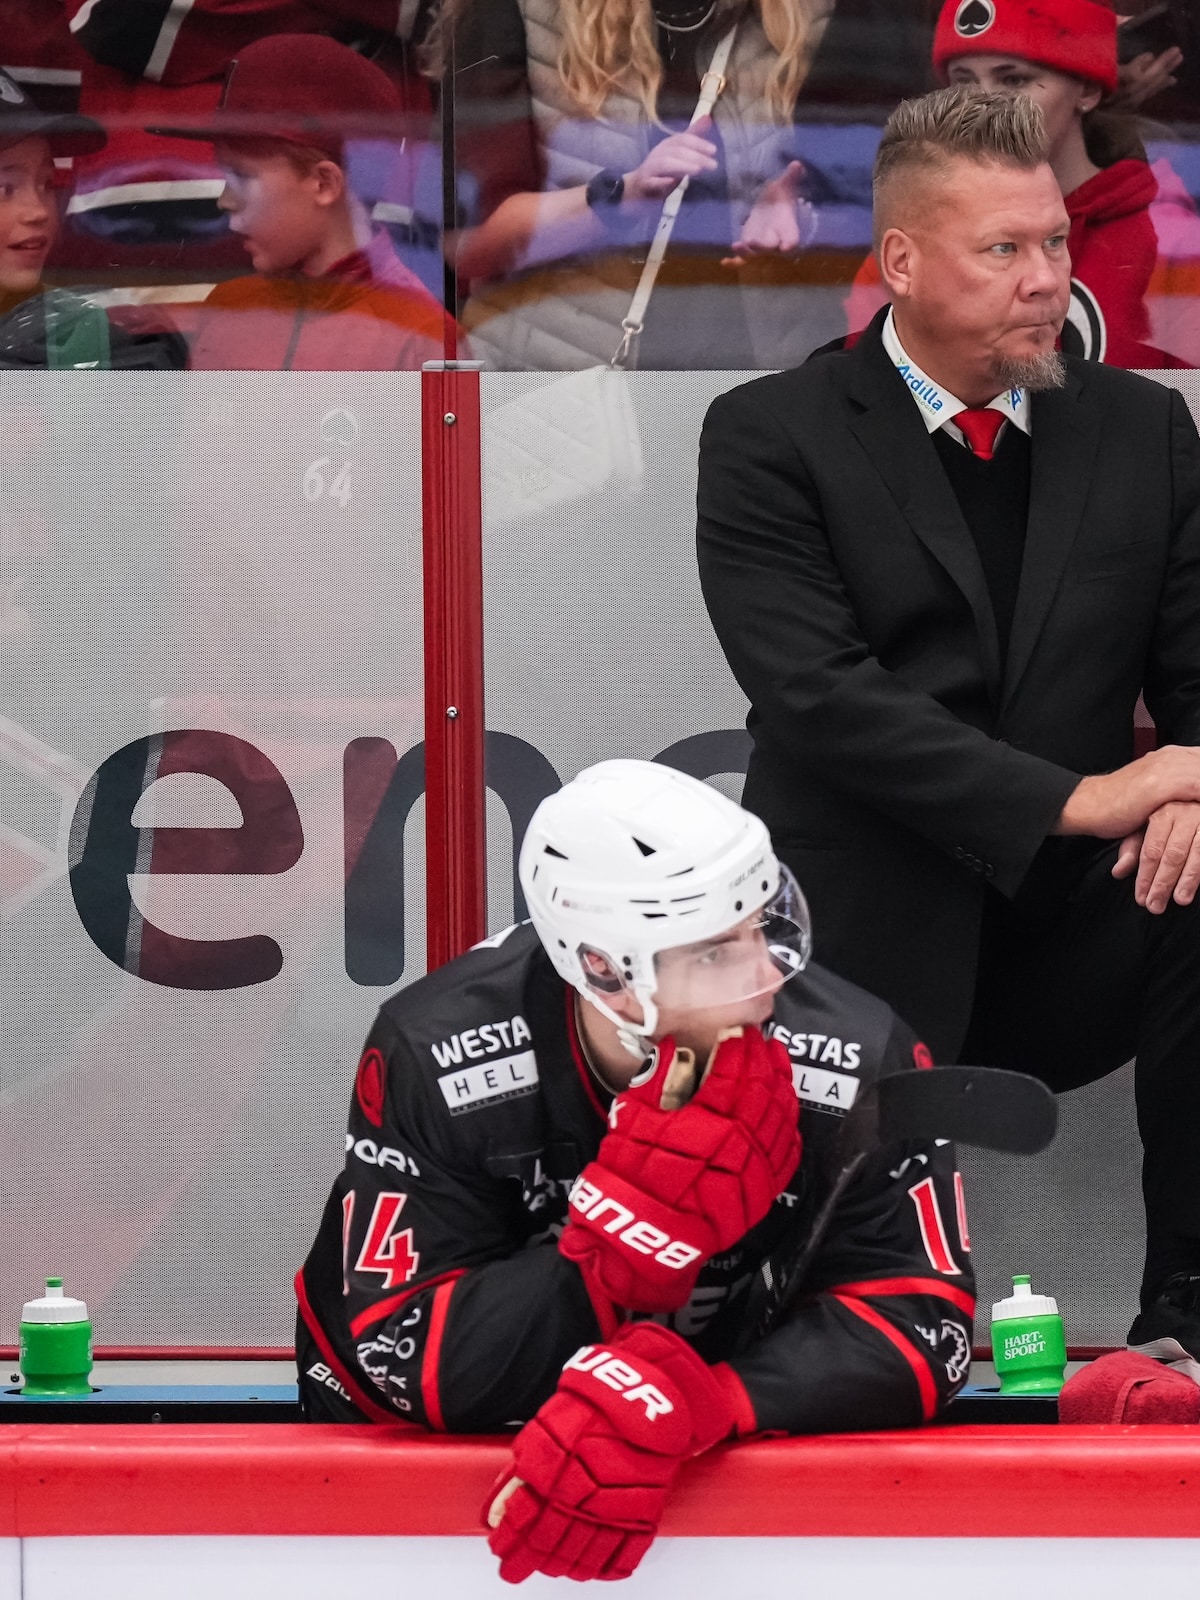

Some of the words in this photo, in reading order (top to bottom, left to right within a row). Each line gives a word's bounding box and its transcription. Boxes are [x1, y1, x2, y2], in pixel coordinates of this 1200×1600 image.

[897, 364, 943, 412] Ardilla
[300, 454, 354, 511] 64
[431, 1015, 532, 1069] WESTA
[764, 1021, 862, 1071] ESTAS
[453, 1063, 525, 1099] HEL
[1004, 1340, 1046, 1360] SPORT
